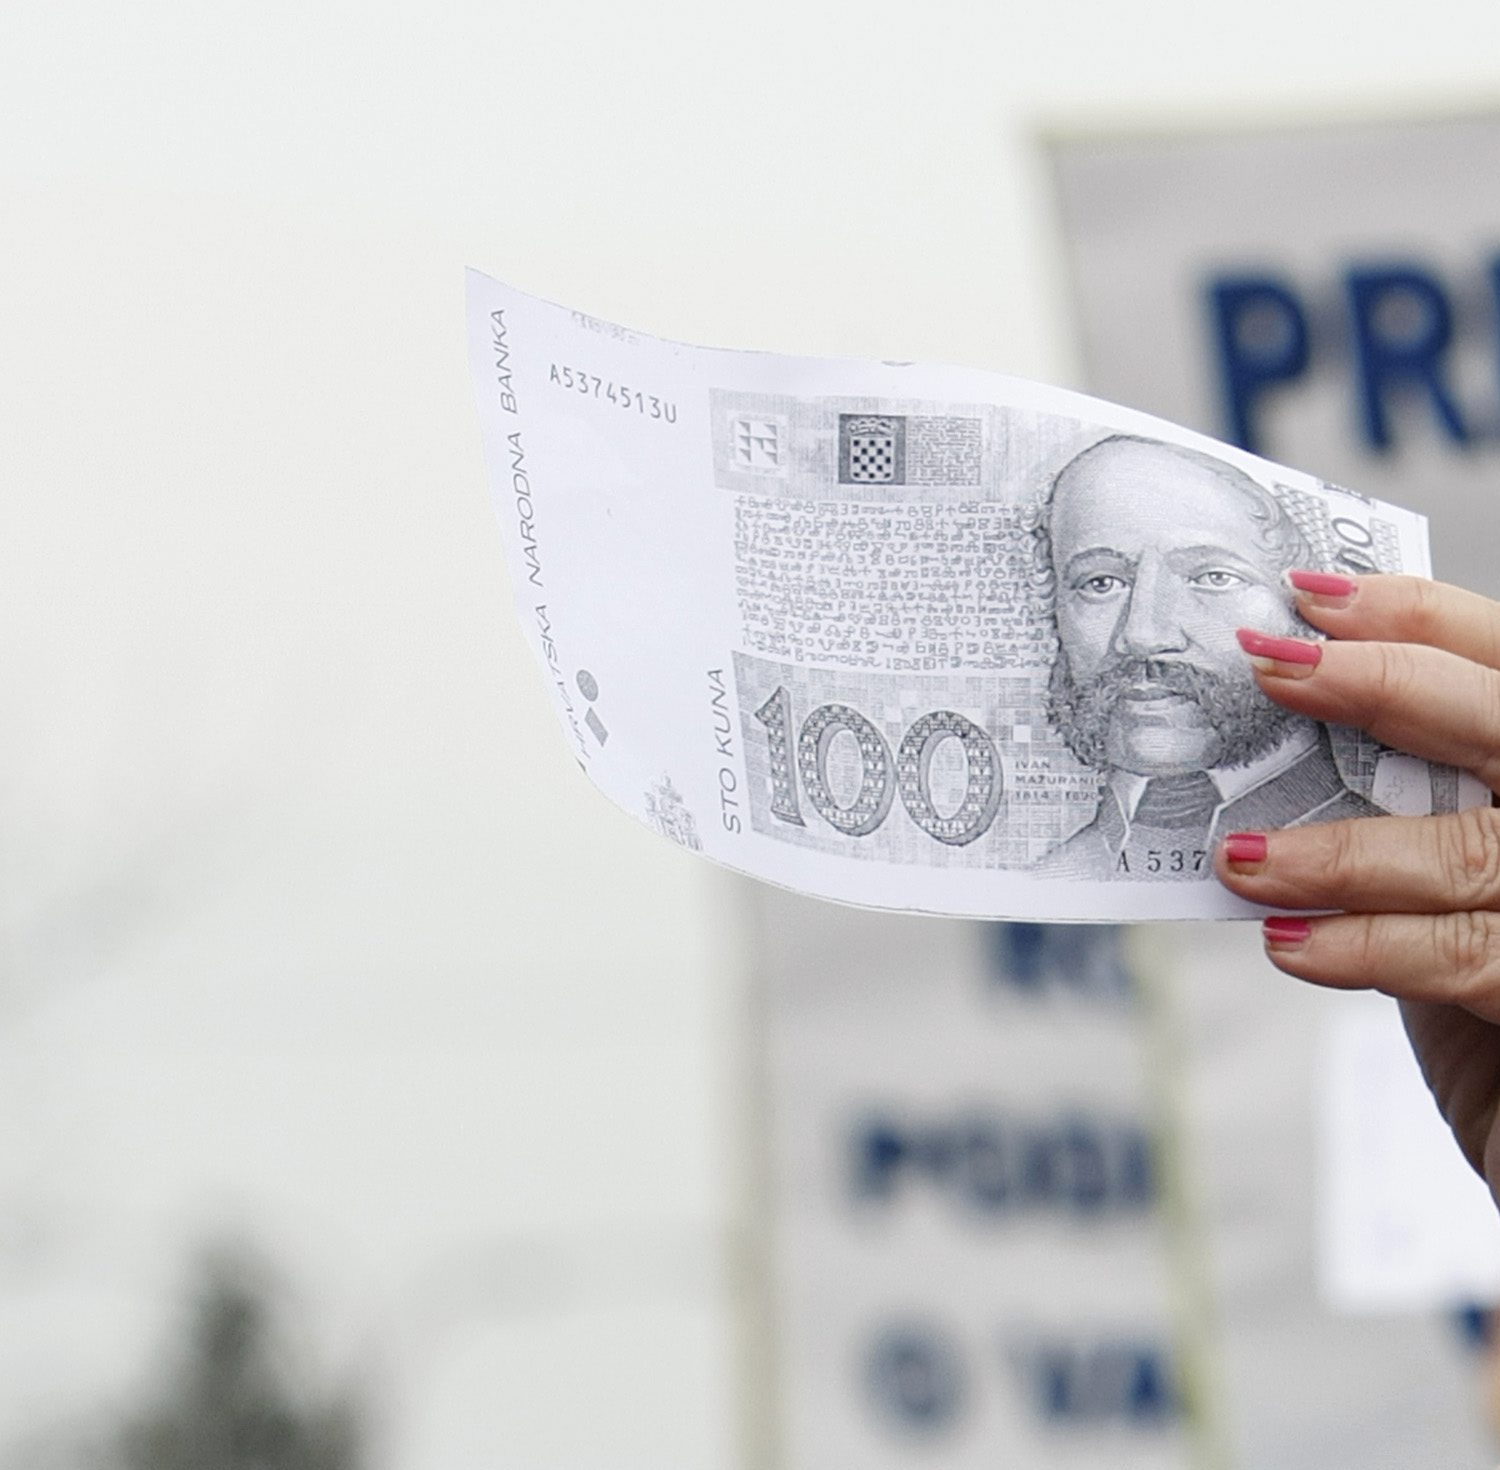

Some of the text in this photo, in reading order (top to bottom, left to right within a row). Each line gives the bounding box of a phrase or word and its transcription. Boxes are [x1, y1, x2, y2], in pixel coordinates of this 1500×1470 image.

[491, 309, 518, 414] BANKA
[550, 363, 677, 424] A5374513U
[508, 432, 543, 587] NARODNA
[707, 668, 742, 834] STO KUNA
[754, 685, 1004, 847] 100
[1115, 850, 1131, 874] A
